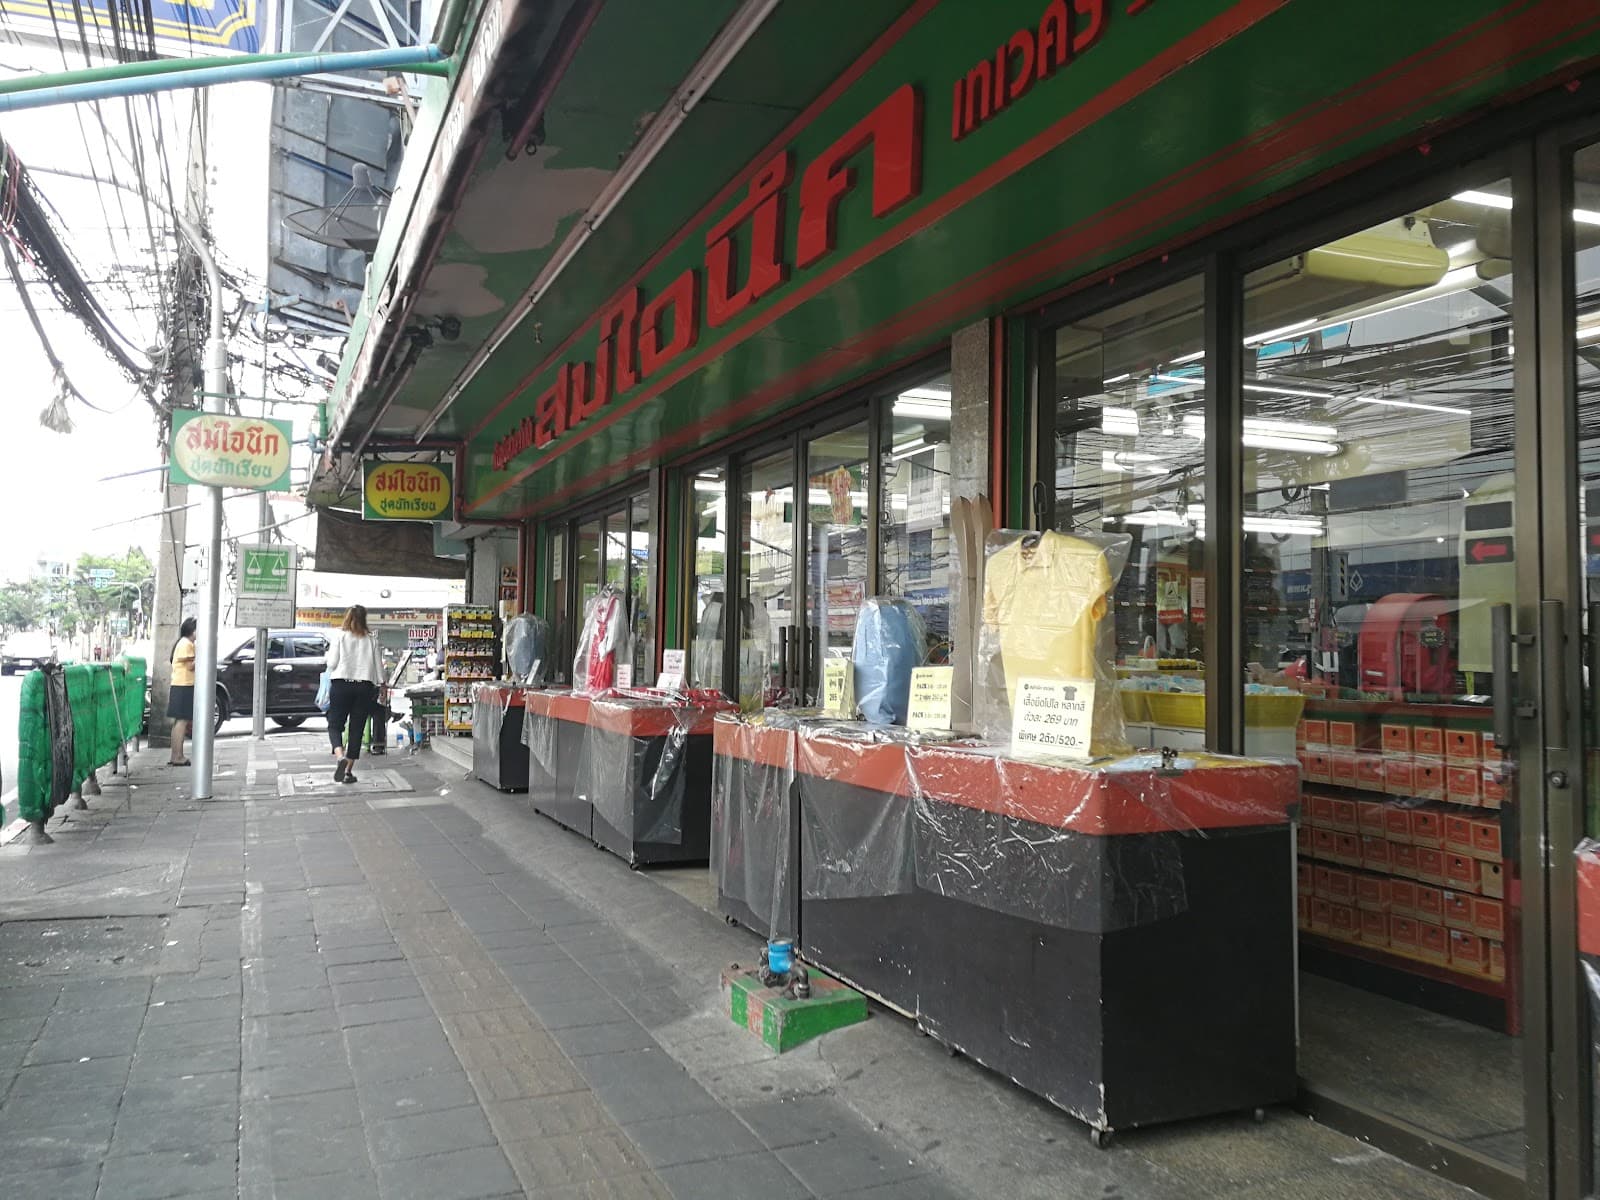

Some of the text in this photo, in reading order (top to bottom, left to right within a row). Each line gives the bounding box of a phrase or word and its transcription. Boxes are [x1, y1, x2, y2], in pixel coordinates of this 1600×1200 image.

[534, 83, 915, 449] สมใจนึก
[187, 420, 279, 456] สมใจนึก
[375, 468, 441, 492] สมใจนึก
[380, 497, 437, 513] ชุดนักเรียน
[1023, 692, 1086, 712] เสื้อยืดโปโล หลากสี
[1043, 713, 1062, 725] 269
[1063, 717, 1079, 727] บาท
[1018, 729, 1037, 742] พิเศษ
